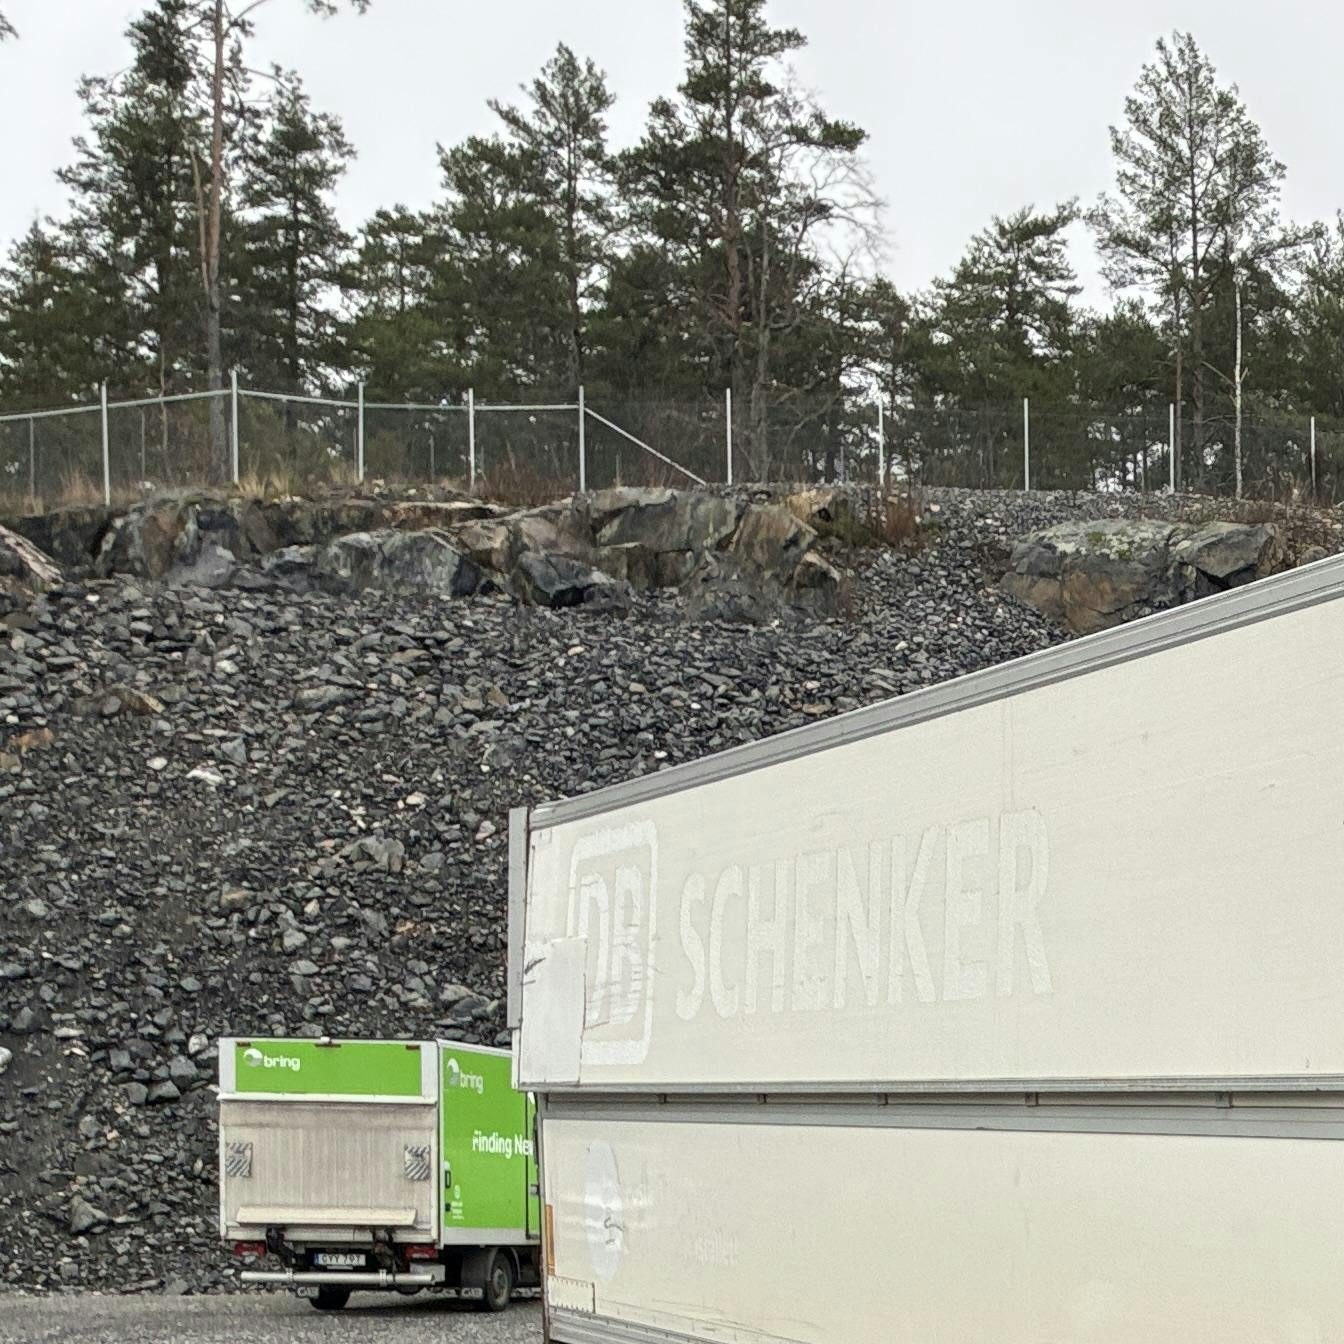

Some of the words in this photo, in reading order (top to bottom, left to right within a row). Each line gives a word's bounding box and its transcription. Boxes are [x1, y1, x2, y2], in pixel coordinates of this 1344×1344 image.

[675, 806, 1054, 1022] SCHENKER
[263, 1053, 301, 1072] bring
[459, 1068, 484, 1094] bring
[472, 1130, 513, 1159] Finding
